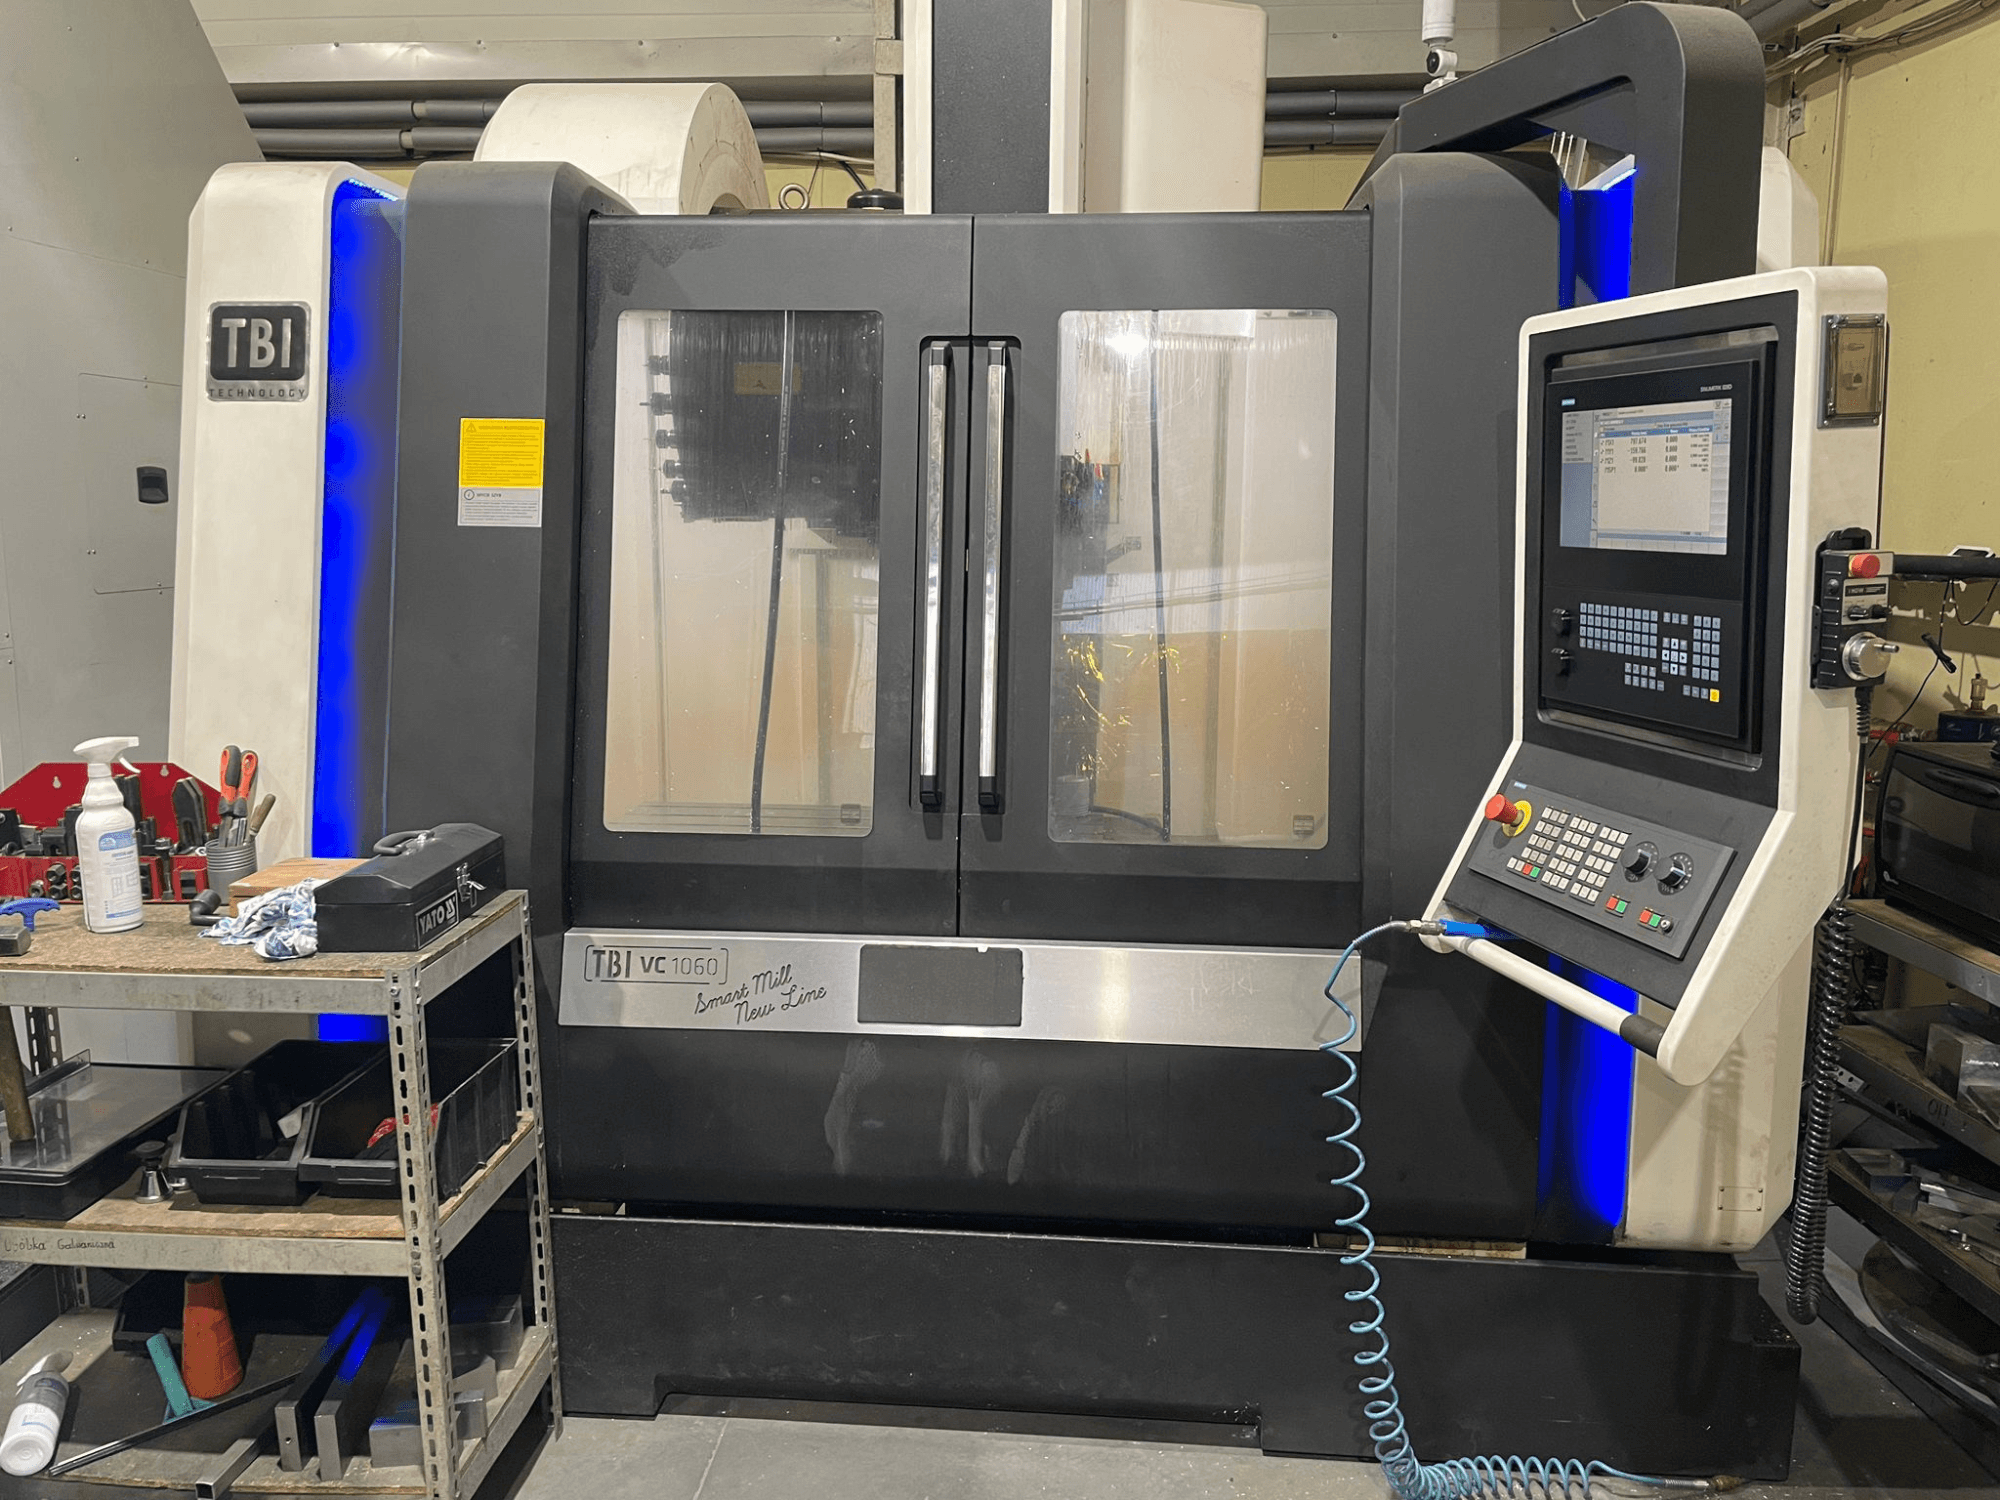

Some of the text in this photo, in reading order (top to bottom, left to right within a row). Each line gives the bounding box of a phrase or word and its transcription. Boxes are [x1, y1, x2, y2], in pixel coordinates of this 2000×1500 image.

[221, 318, 292, 368] TBI
[208, 388, 306, 398] TECHNOLOGY
[419, 905, 445, 935] YATO
[592, 949, 719, 979] TBI VC 1060
[694, 963, 794, 1015] Smart Mill
[733, 983, 828, 1026] New Line
